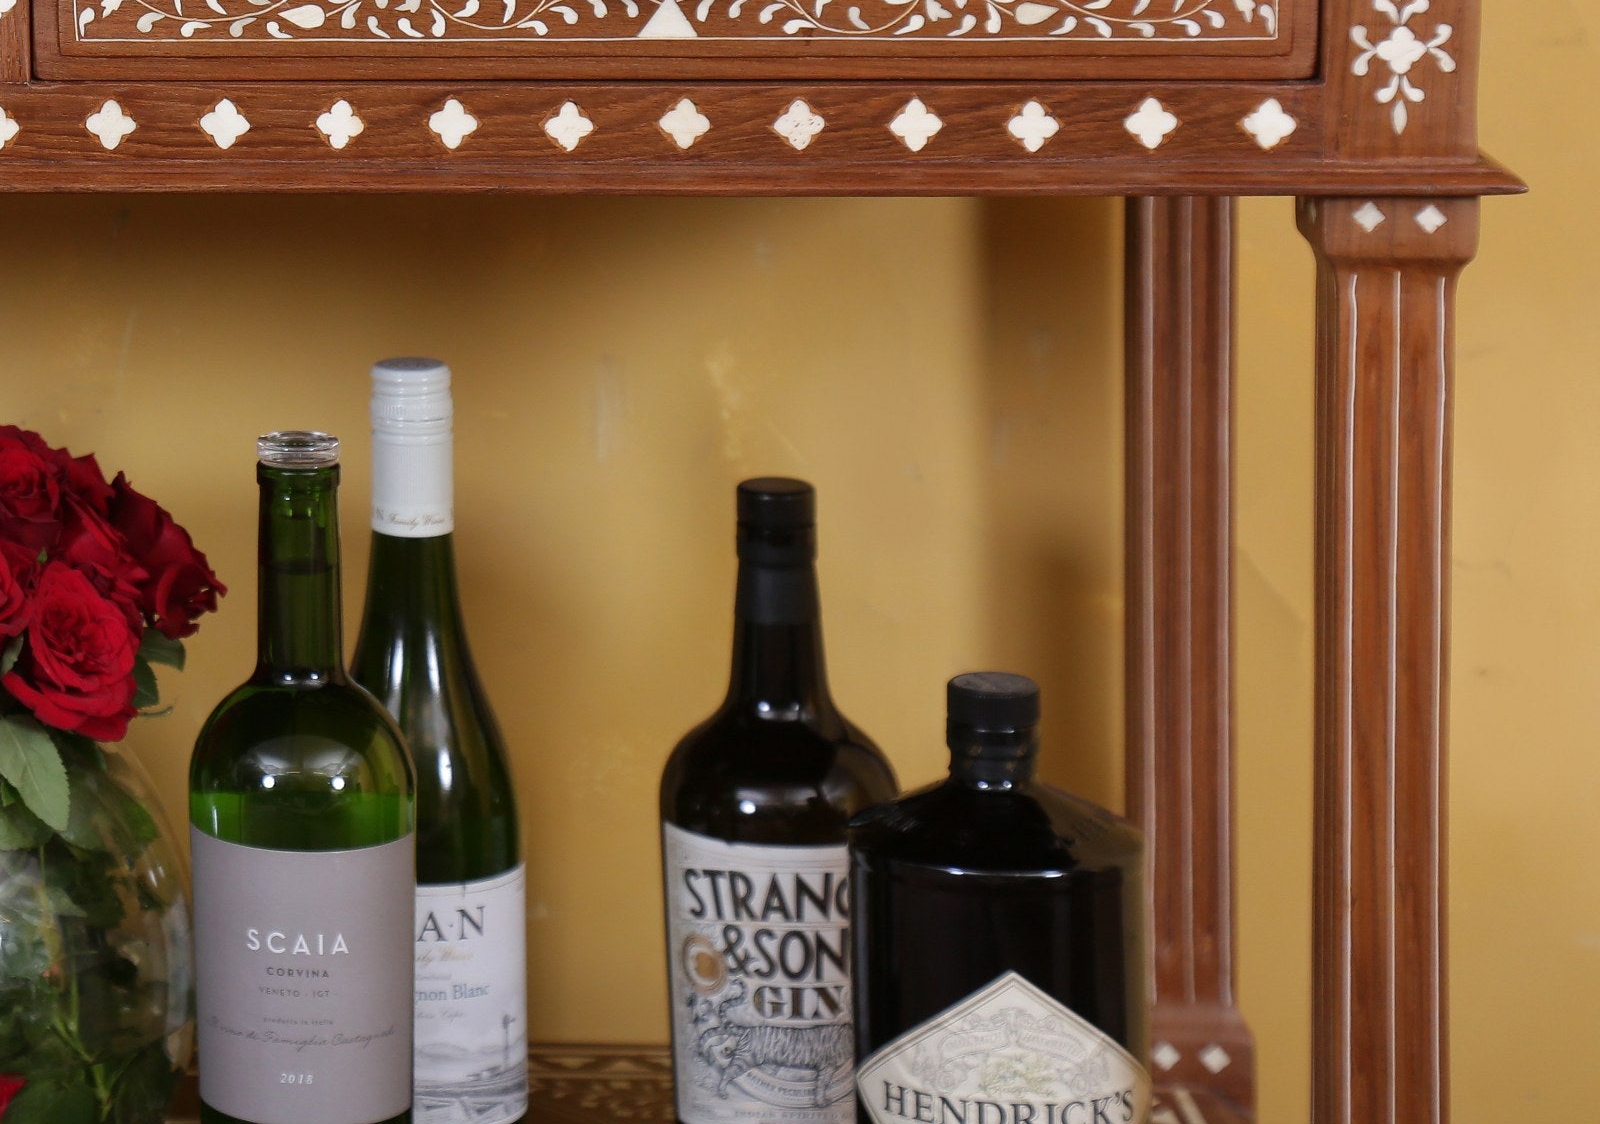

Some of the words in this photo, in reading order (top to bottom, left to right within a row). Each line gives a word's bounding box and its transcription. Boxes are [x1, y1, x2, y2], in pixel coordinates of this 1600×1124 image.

[246, 928, 350, 956] SCAIA
[266, 966, 330, 978] CORVINA
[258, 986, 300, 998] VENETO
[452, 983, 490, 1000] Blanc
[753, 985, 846, 1020] GIN
[883, 1080, 1134, 1124] HENDRICK'S
